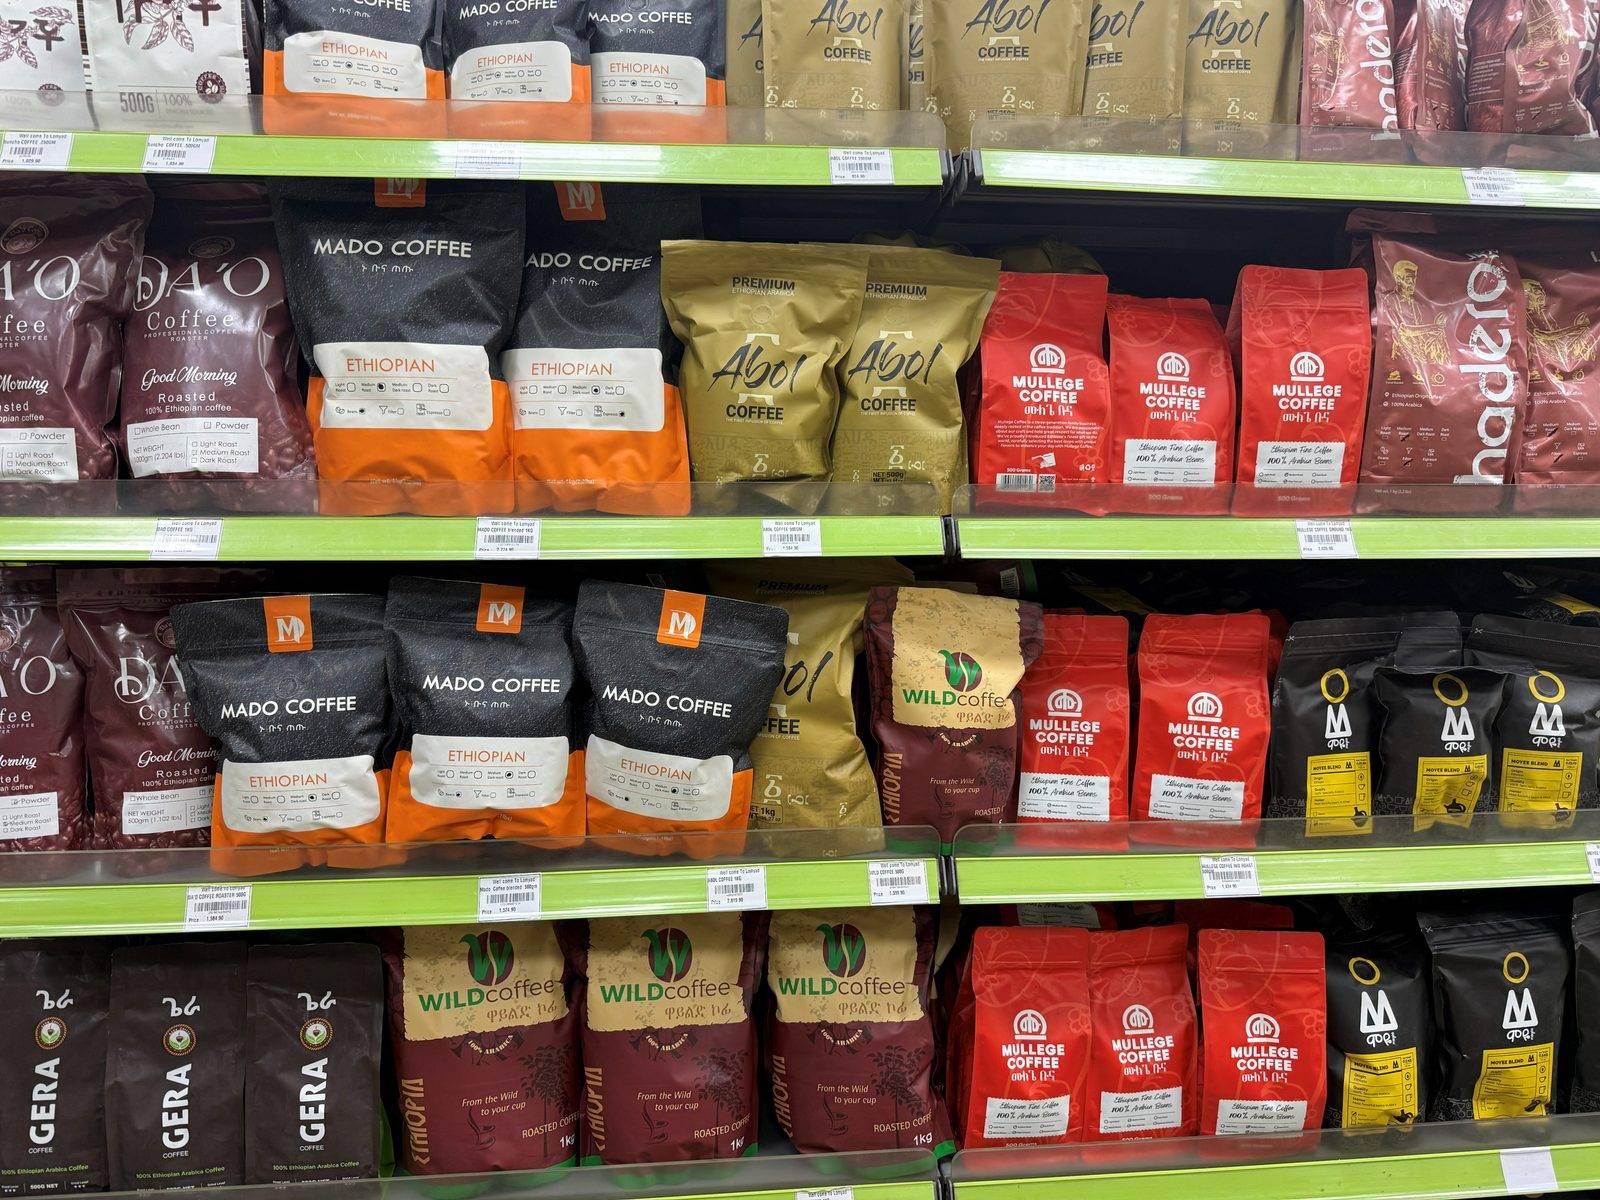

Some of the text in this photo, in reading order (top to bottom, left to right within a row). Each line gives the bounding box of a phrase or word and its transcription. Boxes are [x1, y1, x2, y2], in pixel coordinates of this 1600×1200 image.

[460, 4, 502, 20] MADO
[637, 11, 693, 25] COFFEE
[1187, 2, 1269, 47] Abol
[322, 41, 388, 61] ETHIOPIAN
[824, 46, 872, 61] COFFEE
[978, 46, 1029, 59] COFFEE
[477, 51, 533, 69] ETHIOPIAN
[1202, 58, 1251, 72] COFFEE
[609, 62, 670, 76] ETHIOPIAN
[120, 92, 155, 113] 500G
[314, 238, 472, 258] MADO COFFEE
[579, 255, 653, 273] COFFEE
[732, 276, 796, 291] PREMIUM
[865, 282, 928, 297] PREMIUM
[732, 287, 764, 296] ETHIOPIAN
[147, 311, 234, 330] Coffee
[144, 330, 202, 339] PROFESSIONAL
[347, 357, 435, 373] ETHIOPIAN
[531, 362, 612, 376] ETHIOPIAN
[707, 343, 807, 393] Abol
[847, 340, 943, 386] Abol
[141, 366, 238, 392] Good Morning
[1012, 376, 1084, 391] MULLEGE
[158, 392, 216, 404] Roasted
[1019, 390, 1078, 404] COFFEE
[1139, 382, 1206, 399] MULLEGE
[1272, 384, 1342, 398] MULLEGE
[145, 404, 232, 415] 100% Ethiopian coffee
[860, 398, 916, 412] COFFEE
[1145, 395, 1200, 411] COFFEE
[1278, 397, 1335, 412] COFFEE
[726, 404, 784, 421] COFFEE
[141, 421, 249, 435] Whole Bean Powder
[30, 432, 66, 440] Powder
[200, 440, 217, 448] Light
[15, 451, 32, 459] Light
[1267, 456, 1286, 465] 100%
[1315, 457, 1333, 465] Beans
[34, 468, 56, 476] Roast
[422, 675, 561, 694] MADO COFFEE
[221, 696, 357, 720] MADO COFFEE
[602, 685, 733, 719] MADO COFFEE
[1029, 717, 1101, 734] MULLEGE
[1168, 722, 1240, 739] MULLEGE
[1035, 731, 1094, 745] COFFEE
[1173, 736, 1233, 752] COFFEE
[137, 750, 173, 768] Good
[448, 749, 526, 763] ETHIOPIAN
[1531, 759, 1549, 767] BLEND
[156, 766, 208, 777] Roasted
[620, 758, 692, 781] ETHIOPIAN
[141, 777, 197, 788] 100% Ethiopian
[250, 773, 327, 788] ETHIOPIAN
[929, 777, 976, 785] From the Wild
[21, 796, 50, 805] Powder
[760, 806, 776, 817] 1kg
[974, 807, 1001, 817] ROASTED
[600, 979, 731, 1004] WILDcoffee
[778, 976, 906, 996] WILDcoffee
[418, 978, 556, 1013] WILDcoffee
[1001, 1043, 1065, 1057] MULLEGE
[1111, 1035, 1175, 1051] MULLEGE
[1118, 1049, 1170, 1064] COFFEE
[1230, 1046, 1299, 1060] MULLEGE
[1006, 1055, 1059, 1070] COFFEE
[1236, 1057, 1293, 1071] COFFEE
[29, 1056, 61, 1145] GERA
[162, 1063, 192, 1150] GERA
[299, 1057, 329, 1143] GERA
[461, 1090, 518, 1108] From the Wild
[480, 1100, 526, 1116] to your cup
[521, 1121, 558, 1139] ROASTED
[873, 1119, 911, 1134] ROASTED
[912, 1133, 933, 1147] 1kg
[28, 1146, 54, 1155] COFFEE
[162, 1150, 189, 1159] COFFEE
[17, 1167, 45, 1176] Ethiopian
[46, 1166, 68, 1174] Arabica
[69, 1164, 89, 1172] Coffee
